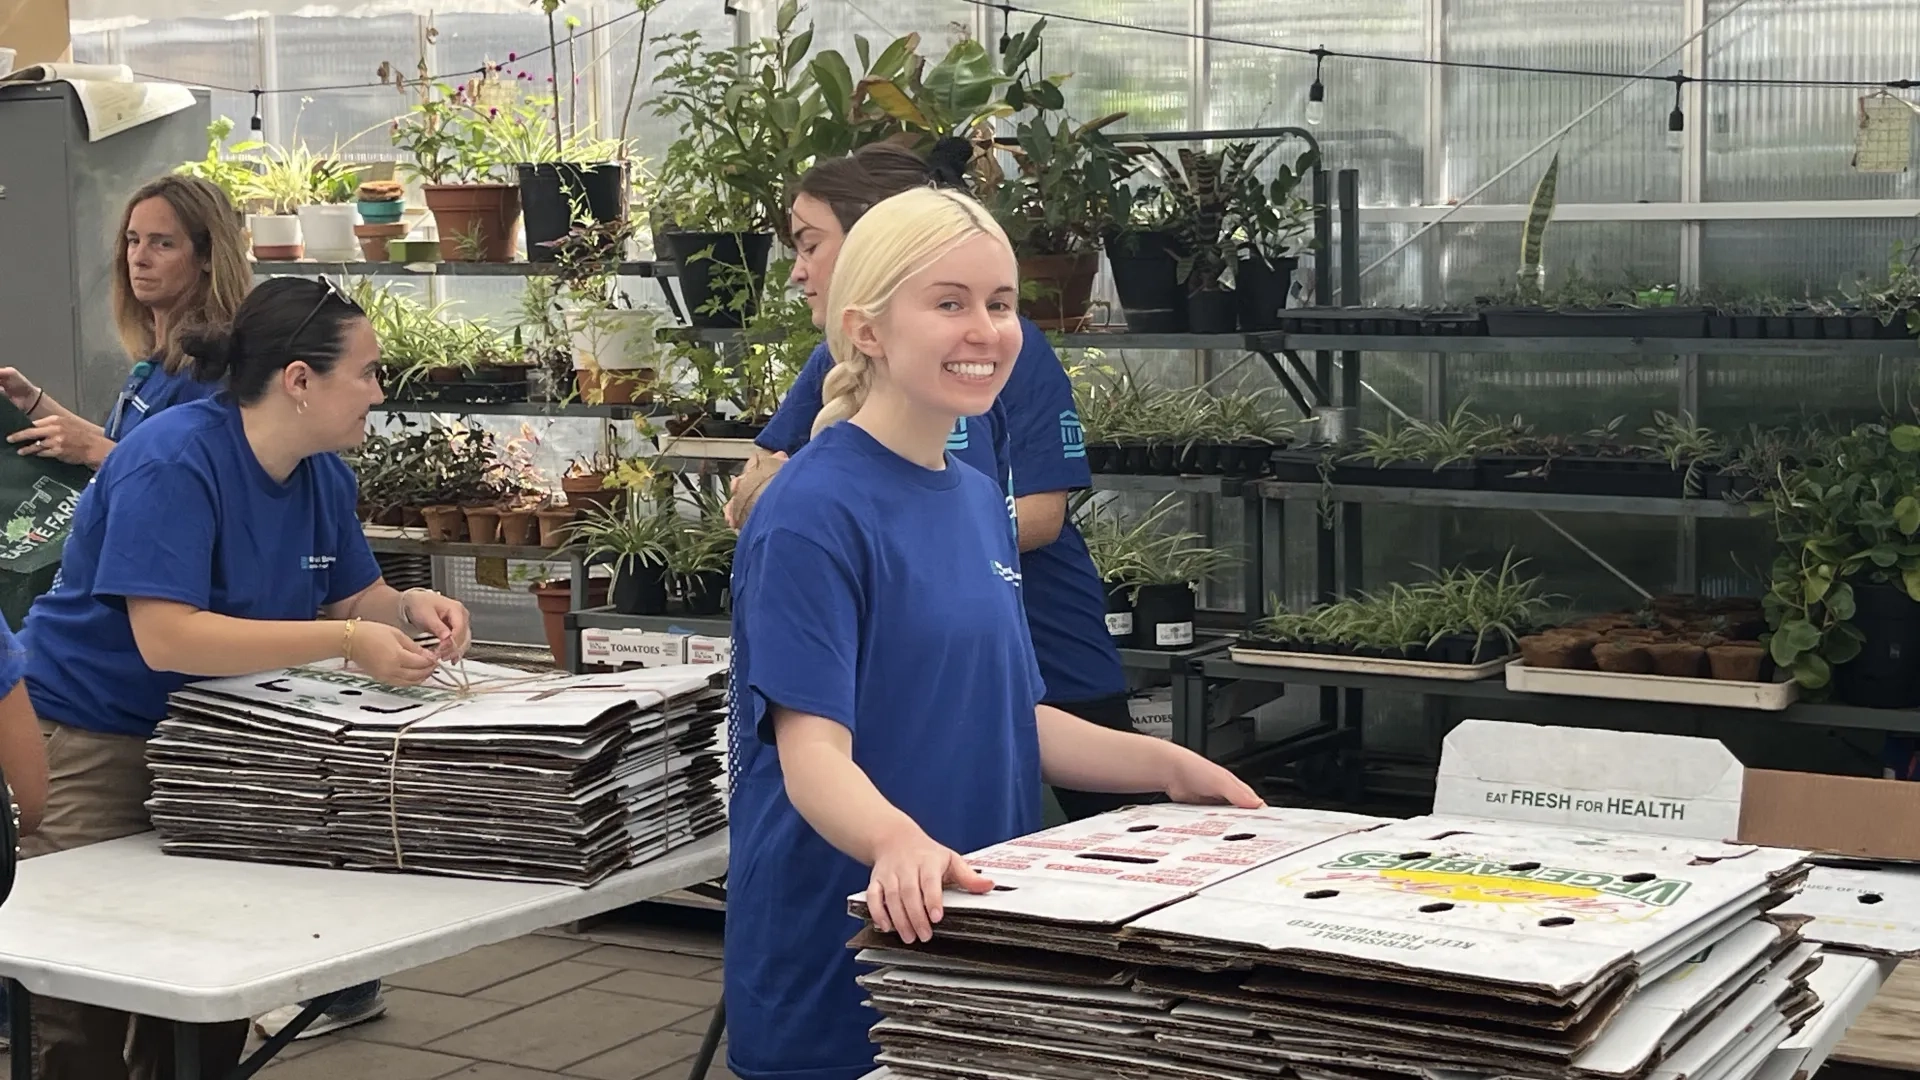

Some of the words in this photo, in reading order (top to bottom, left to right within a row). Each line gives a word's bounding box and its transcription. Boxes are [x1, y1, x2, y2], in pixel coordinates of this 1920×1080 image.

[610, 643, 660, 655] TOMATOES
[1485, 792, 1508, 803] EAT
[1510, 790, 1571, 809] FRESH
[1575, 799, 1603, 813] FOR
[1606, 797, 1685, 820] HEALTH
[1317, 851, 1692, 906] VEGETABLES
[1287, 919, 1424, 942] REFRIGERATED
[1307, 929, 1424, 950] PERISHABLE
[1424, 938, 1476, 950] KEEP
